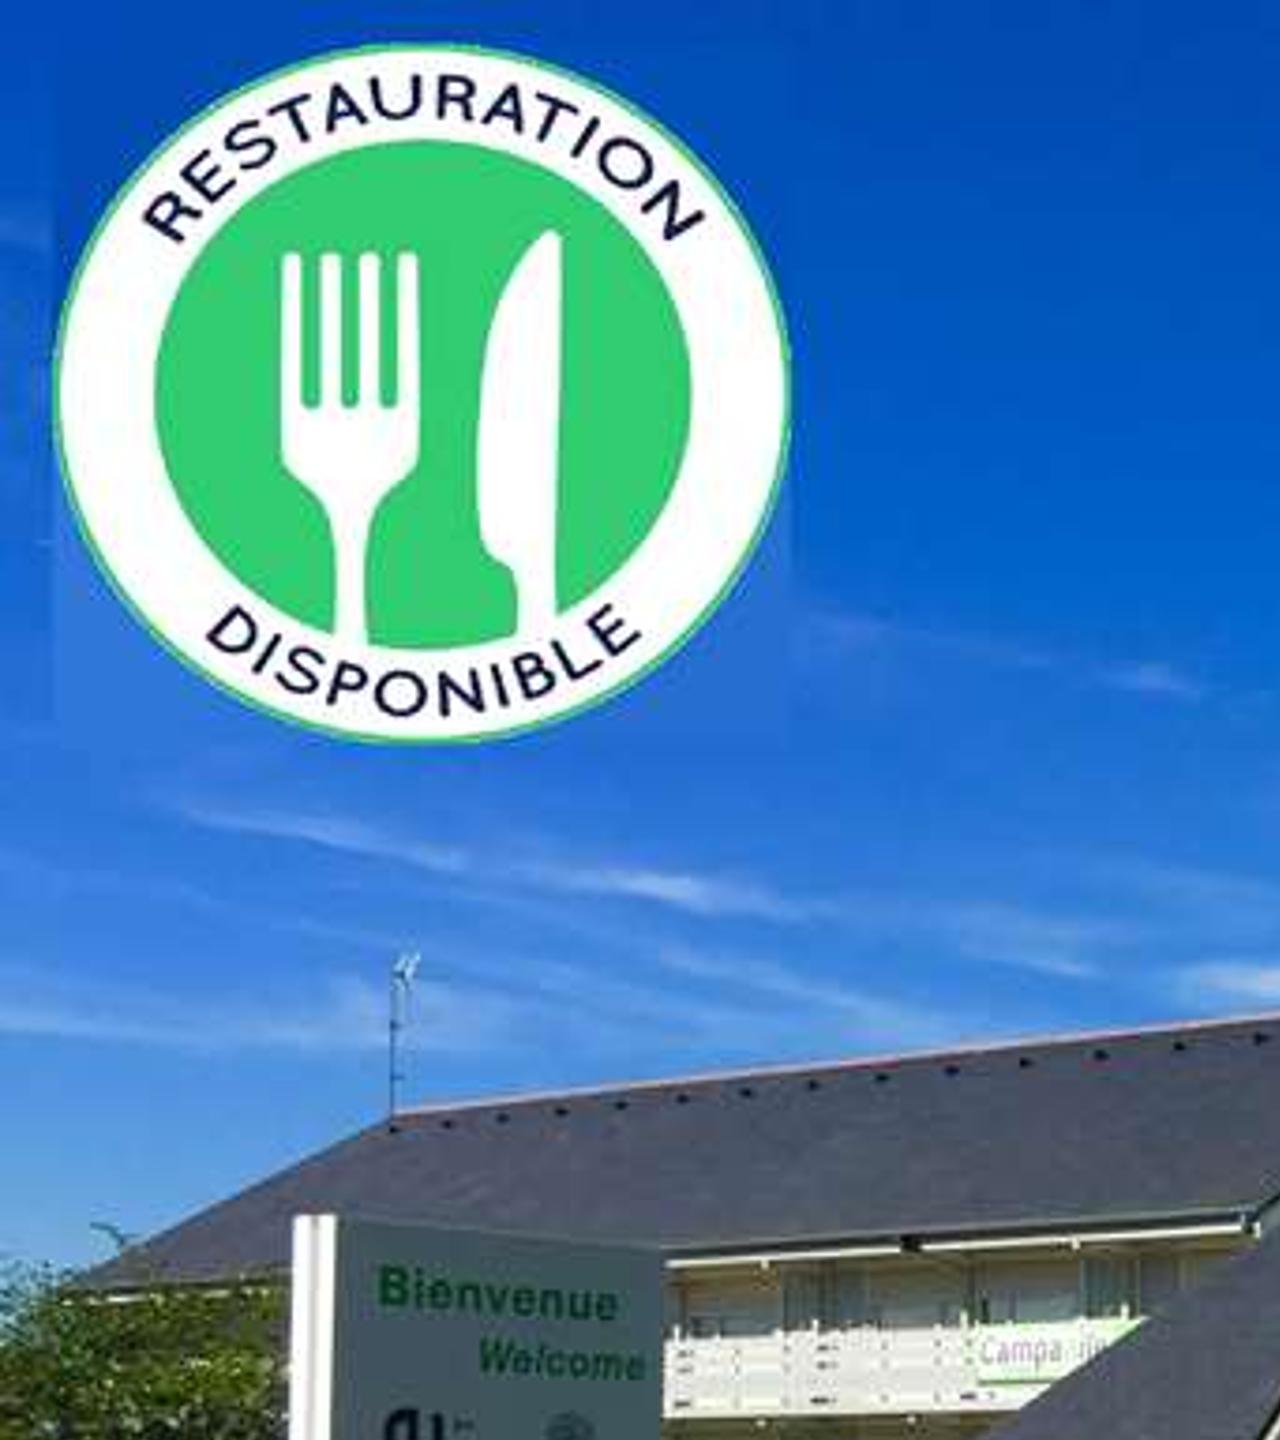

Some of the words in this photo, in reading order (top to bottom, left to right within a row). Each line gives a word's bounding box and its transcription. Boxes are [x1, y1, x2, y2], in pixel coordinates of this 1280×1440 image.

[377, 1263, 619, 1321] Bienvenue
[479, 1337, 647, 1380] Welcome
[981, 1326, 1106, 1371] Campail
